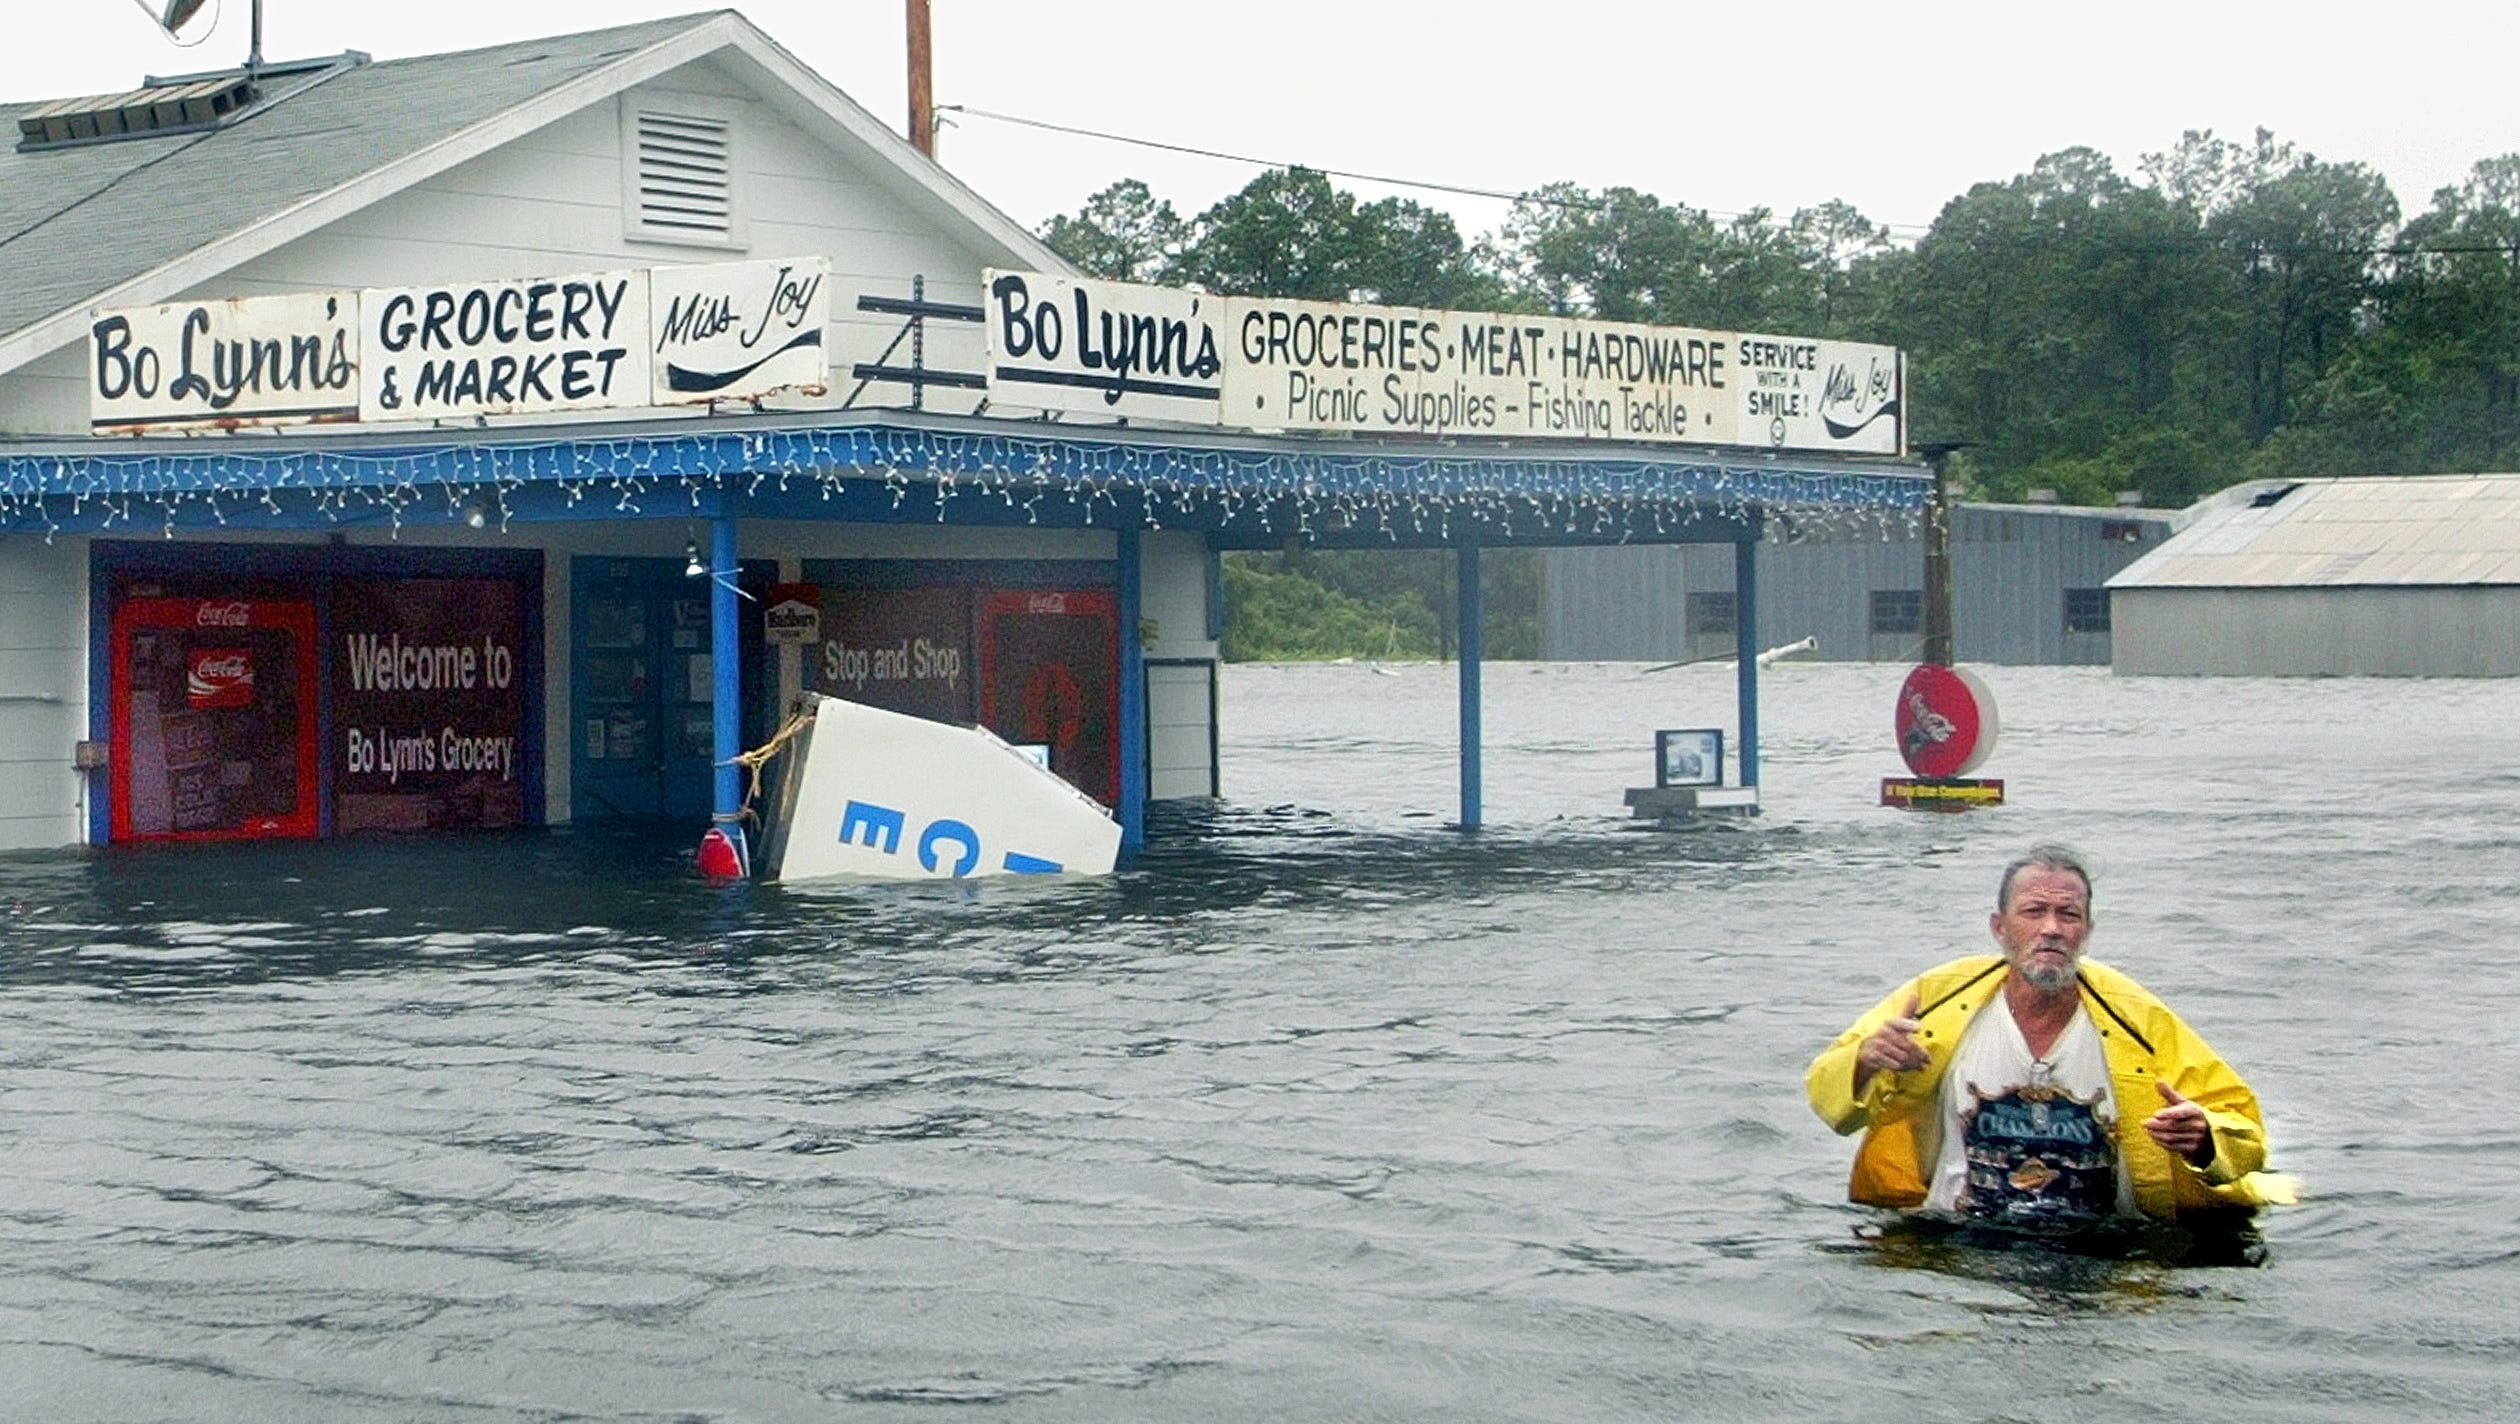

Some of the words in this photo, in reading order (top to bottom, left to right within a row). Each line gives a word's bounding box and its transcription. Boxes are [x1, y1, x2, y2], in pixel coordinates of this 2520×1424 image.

[380, 280, 628, 352] GROCERY
[656, 293, 741, 354] Miss
[740, 266, 823, 348] Joy
[92, 315, 160, 399] Bo
[170, 297, 360, 409] Lynn's
[992, 275, 1062, 361] Bo
[1075, 288, 1221, 406] Lynn's
[1242, 310, 1441, 373] GROCERIES
[1462, 324, 1544, 377] MEAT
[1563, 331, 1726, 389] HARDWARE
[1740, 340, 1816, 371] SERVICE
[380, 365, 402, 409] &
[414, 349, 627, 406] MARKET
[1289, 370, 1368, 423] Picnic
[1383, 373, 1497, 433] Supplies
[1528, 381, 1612, 438] Fishing
[1619, 386, 1687, 436] Tackle
[1757, 371, 1788, 388] WITH
[1793, 373, 1800, 389] A
[1818, 363, 1857, 413] Miss
[1854, 356, 1892, 413] Joy
[348, 633, 477, 692] Welcome
[484, 635, 512, 689] to
[824, 639, 869, 691] Stop
[873, 640, 908, 679] and
[914, 635, 960, 690] Shop
[349, 728, 374, 773] Bo
[380, 726, 436, 784] Lynn's
[441, 726, 514, 781] Grocery
